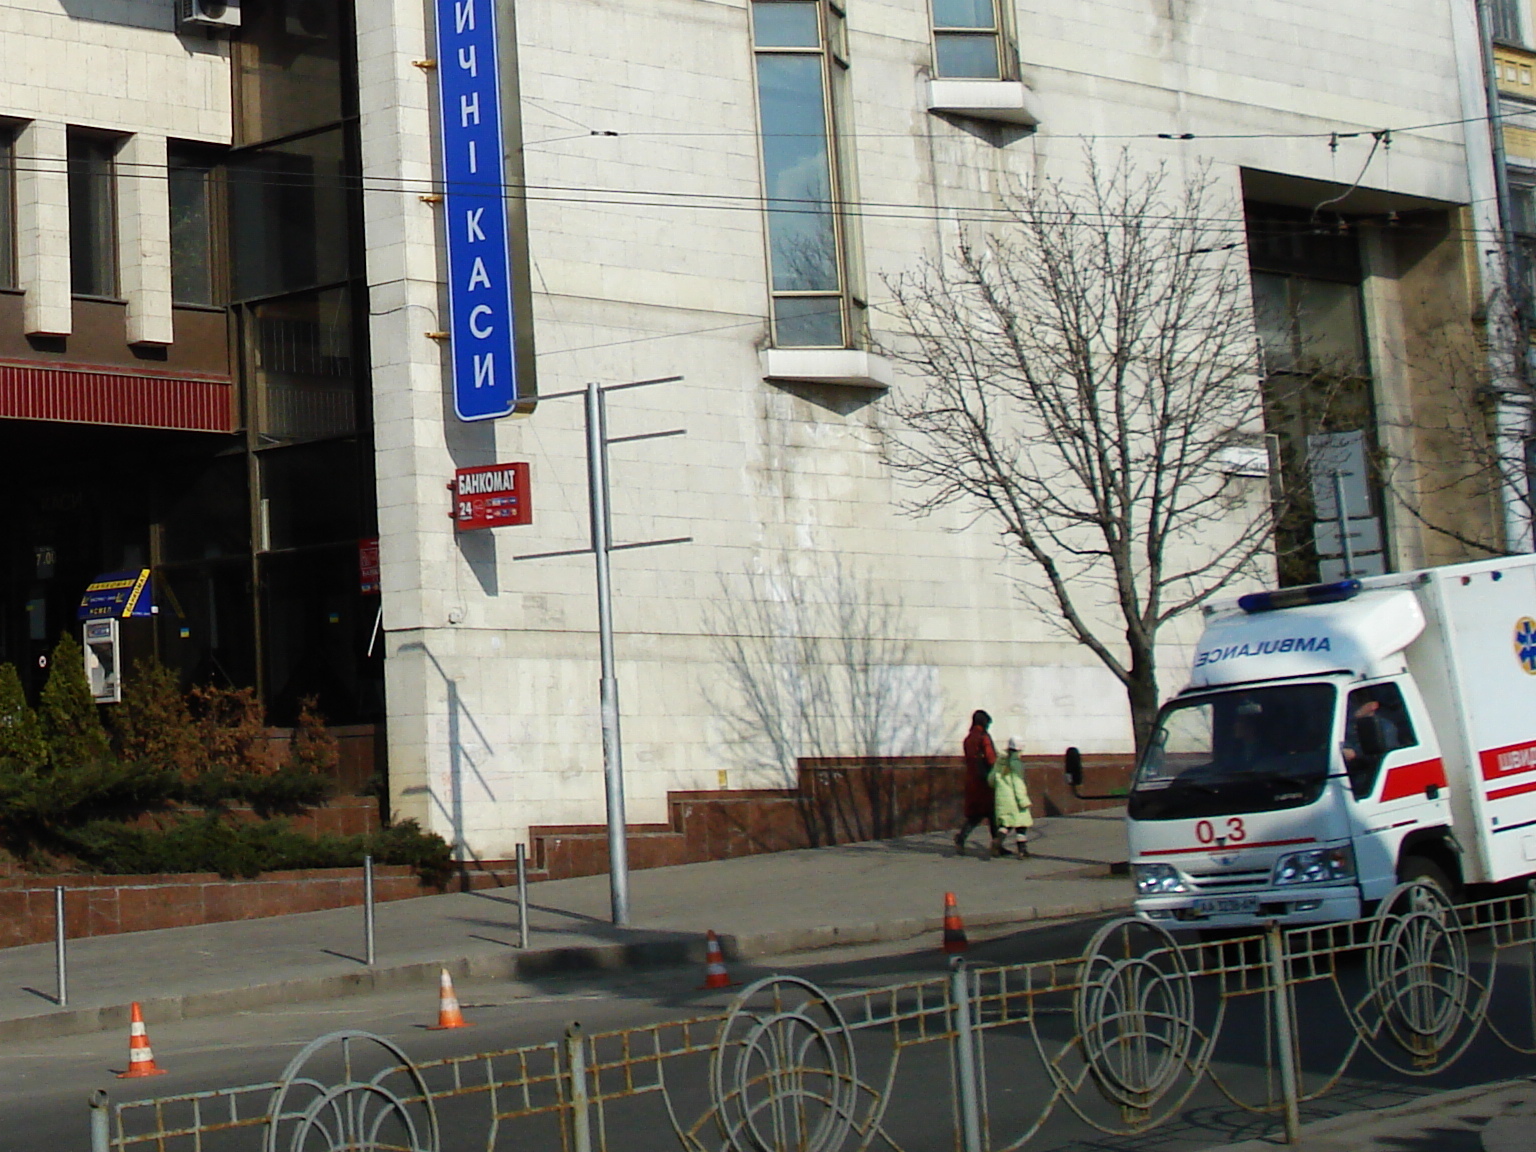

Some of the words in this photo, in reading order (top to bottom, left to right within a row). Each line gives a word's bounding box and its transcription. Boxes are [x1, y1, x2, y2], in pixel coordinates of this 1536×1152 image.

[466, 207, 495, 389] КАСИ
[458, 469, 516, 496] БАНКОМАТ
[459, 501, 473, 517] 24
